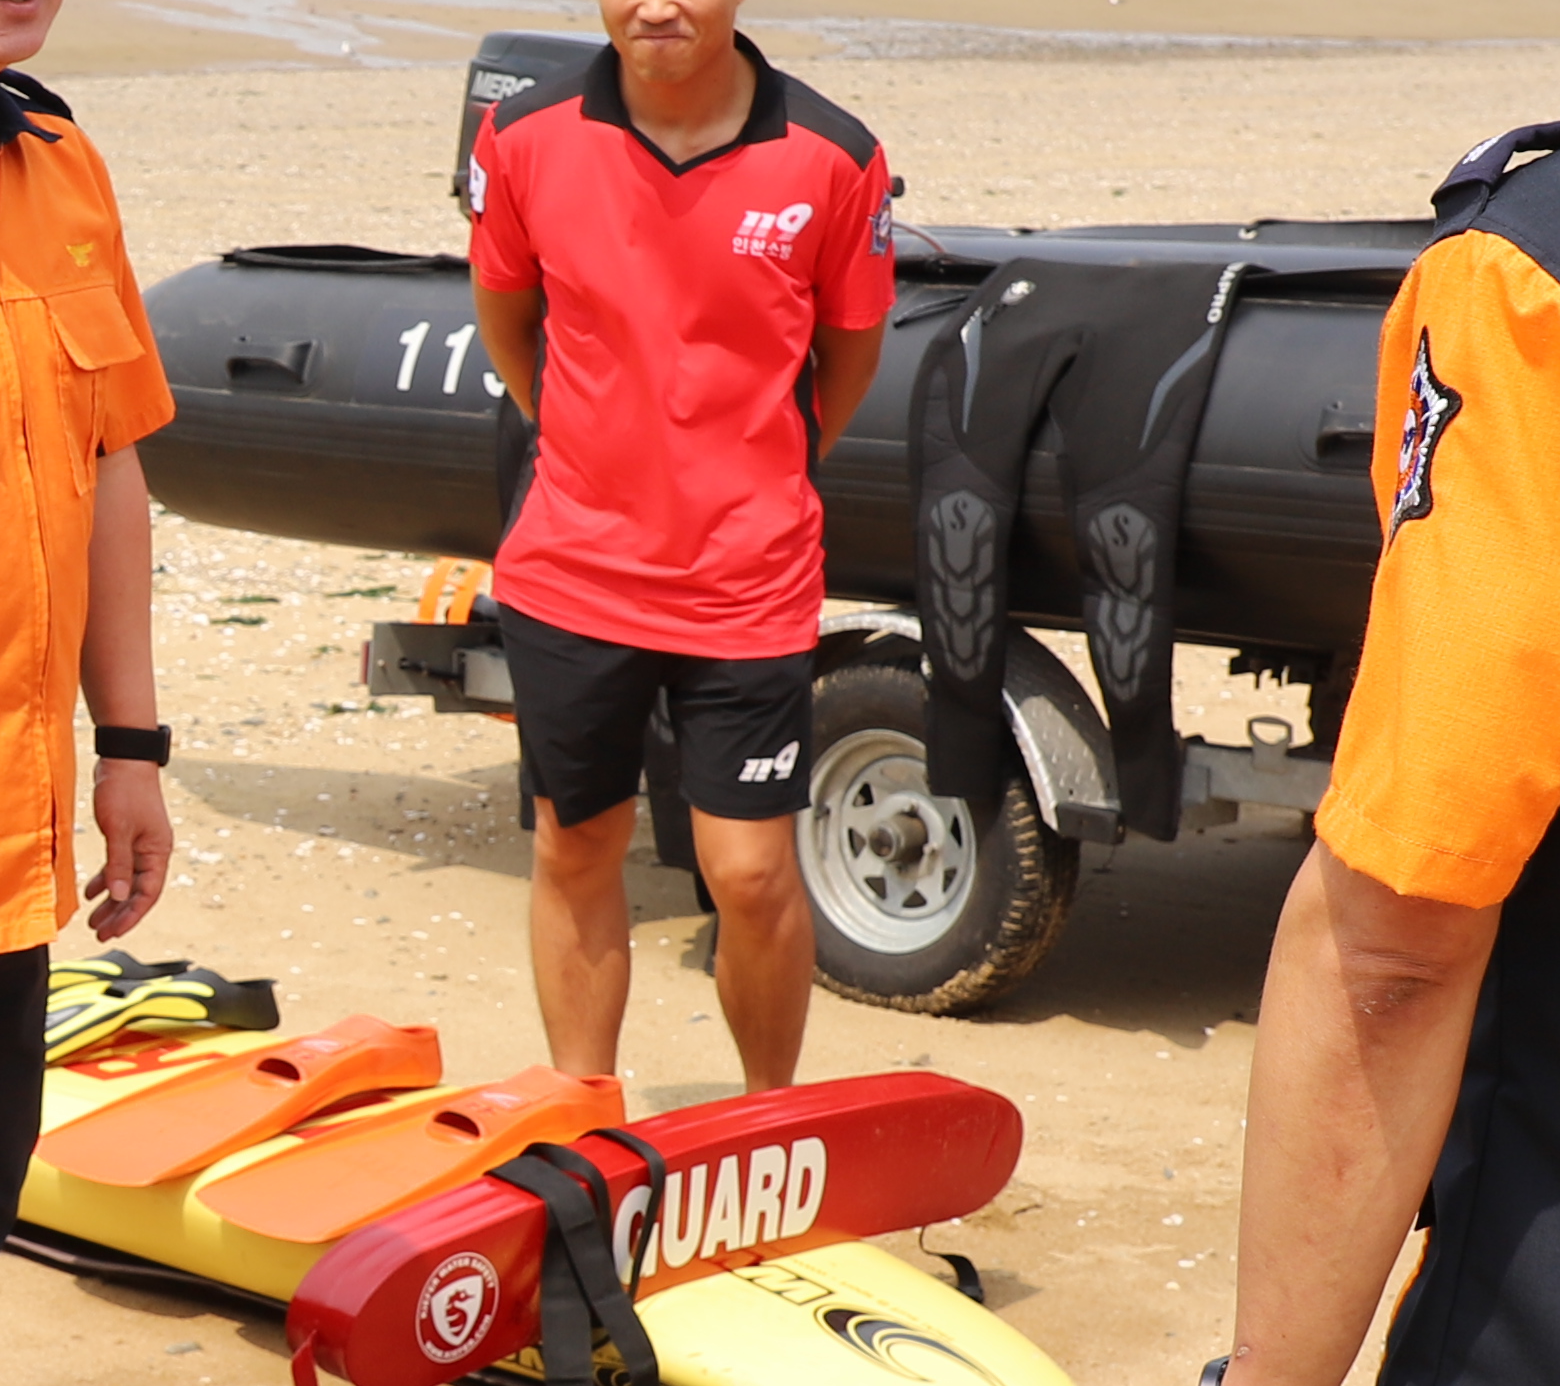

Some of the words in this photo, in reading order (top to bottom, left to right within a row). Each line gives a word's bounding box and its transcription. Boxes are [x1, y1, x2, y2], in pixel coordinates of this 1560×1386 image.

[737, 202, 814, 242] 119
[738, 740, 800, 782] 119
[613, 1136, 827, 1286] GUARD
